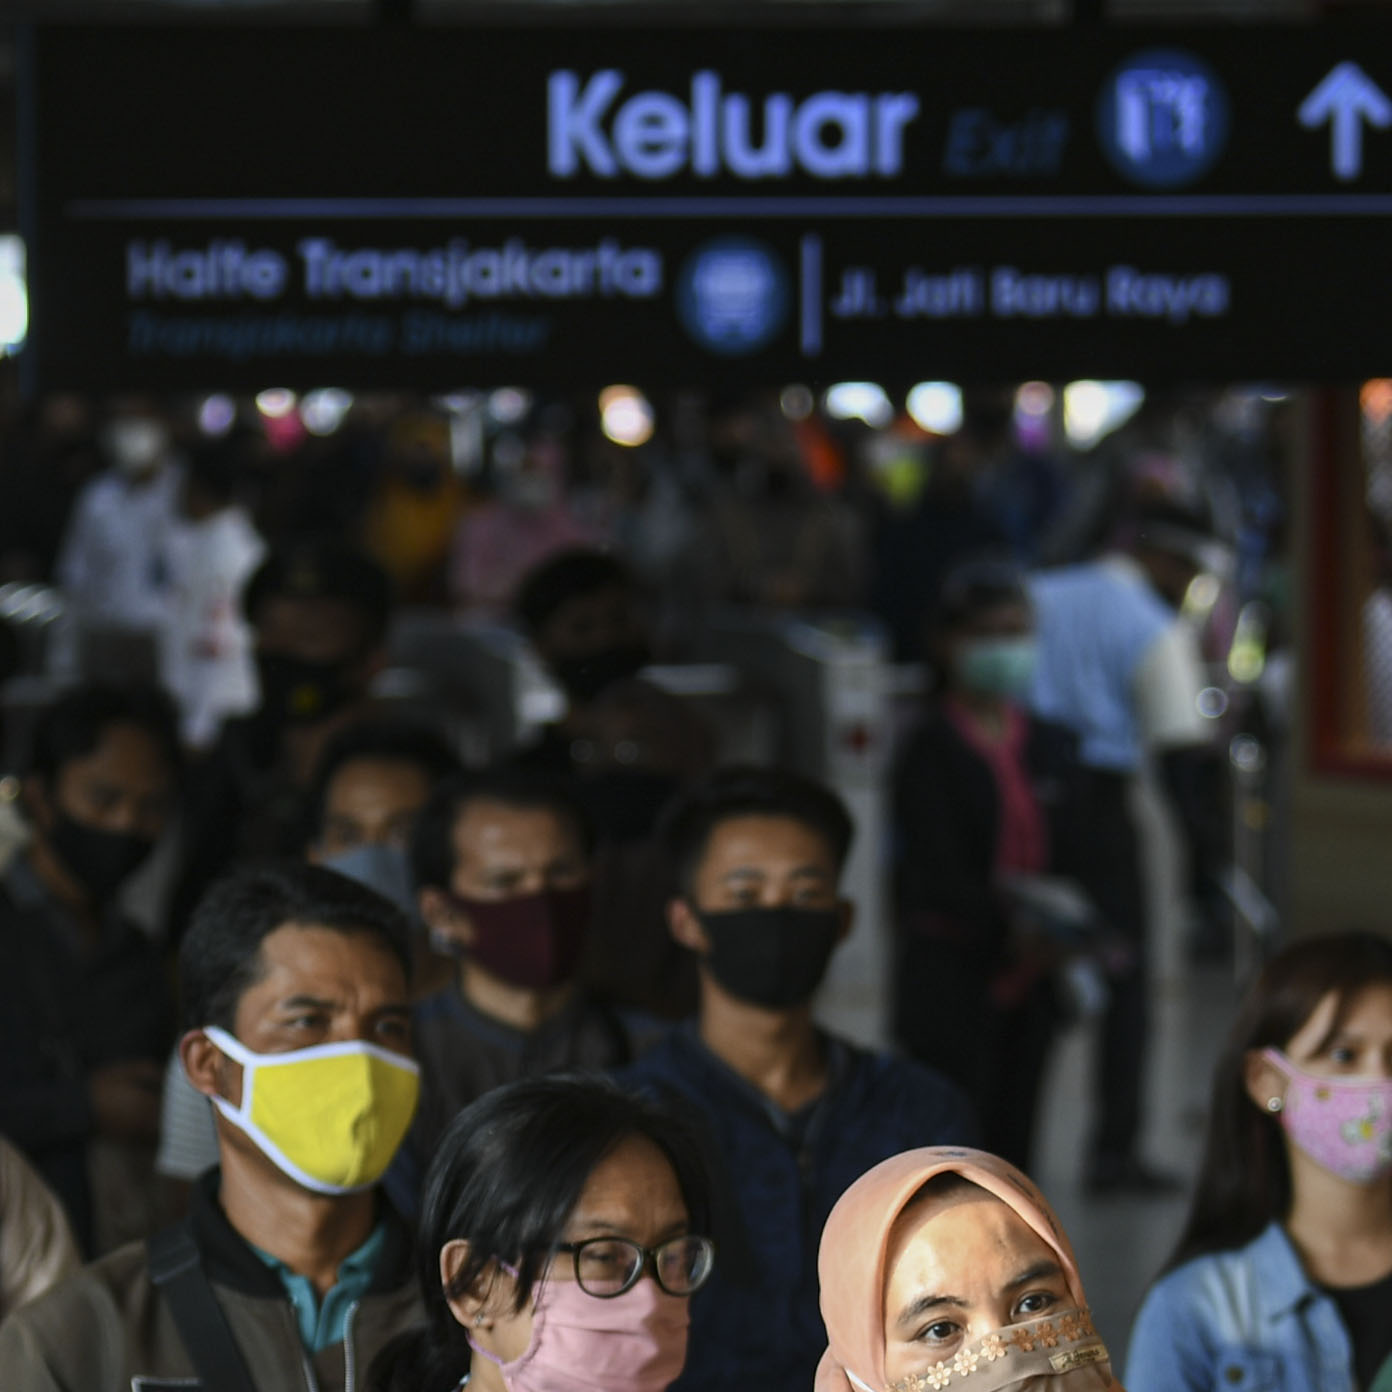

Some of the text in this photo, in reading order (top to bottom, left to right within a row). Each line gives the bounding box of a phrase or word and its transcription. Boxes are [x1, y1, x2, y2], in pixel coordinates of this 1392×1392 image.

[546, 68, 921, 180] Keluar
[126, 236, 666, 309] Halte Transjakarta
[1106, 264, 1231, 325] Raya
